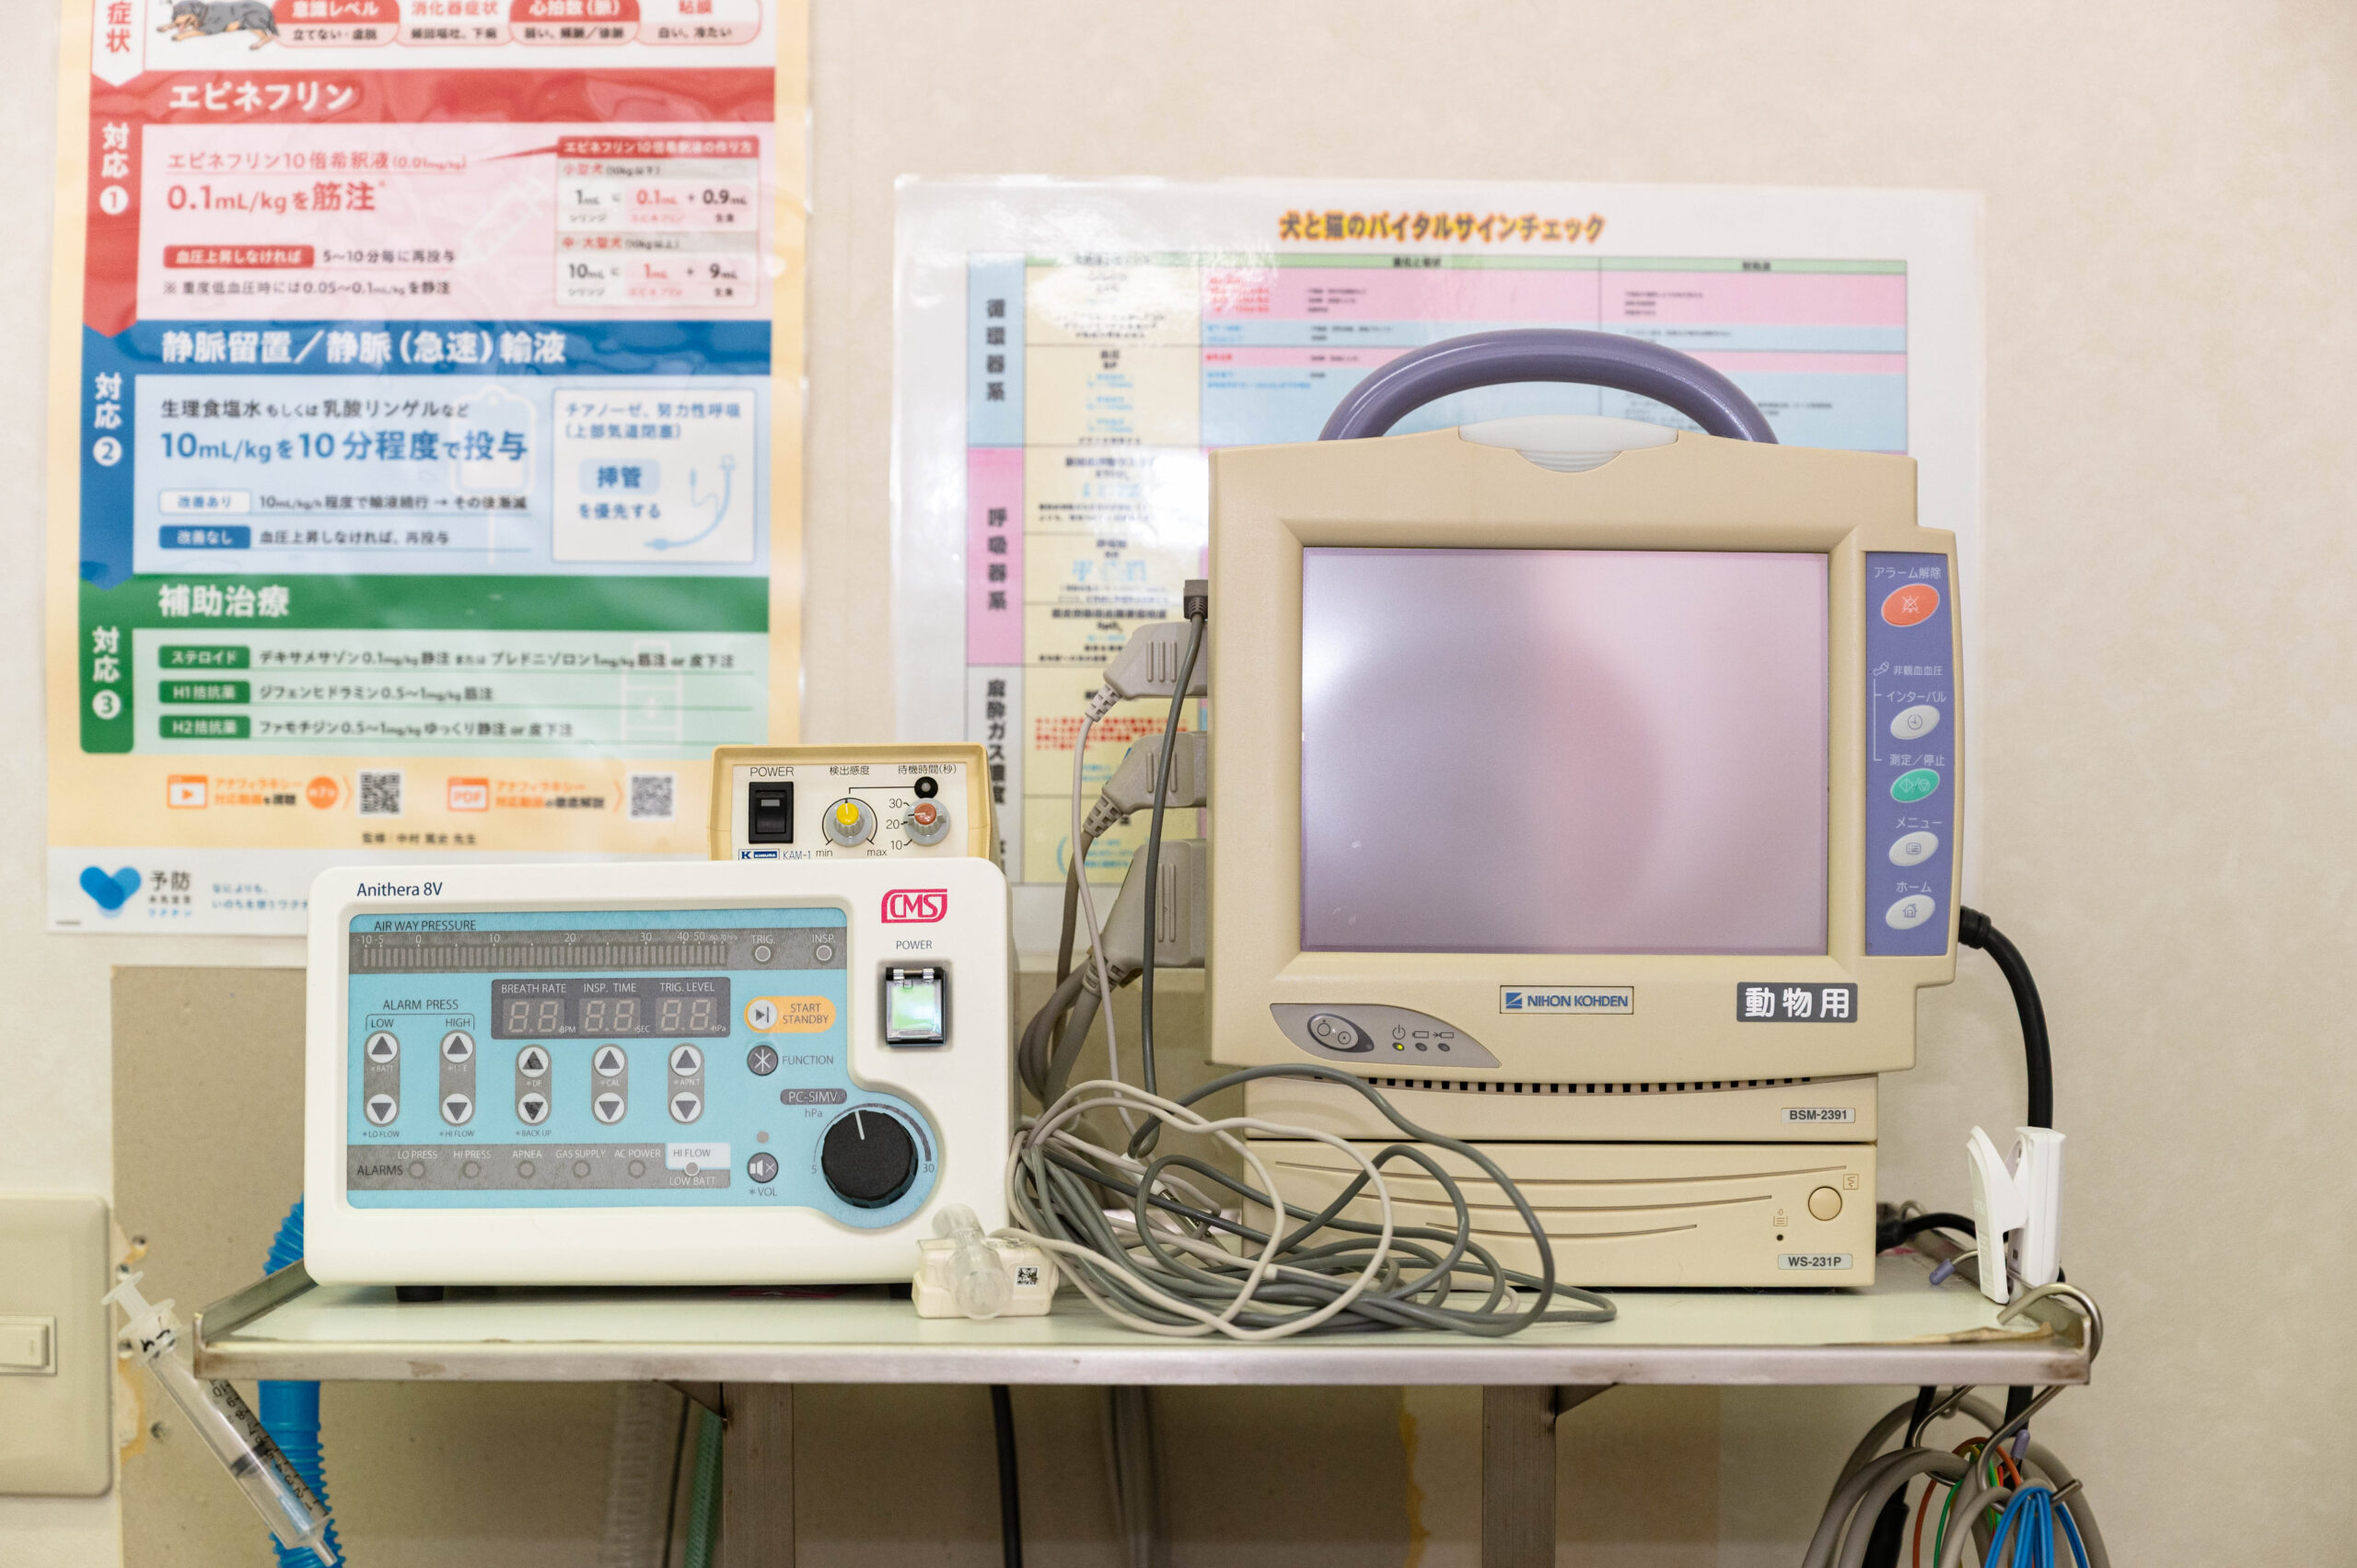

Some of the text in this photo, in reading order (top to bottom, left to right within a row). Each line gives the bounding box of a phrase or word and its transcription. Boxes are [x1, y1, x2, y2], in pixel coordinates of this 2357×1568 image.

[106, 2, 132, 53] 症状
[168, 81, 354, 112] エピネフリン
[101, 122, 130, 179] 対応
[1278, 210, 1606, 243] 犬と猫のバイタルサインチェック
[176, 249, 303, 264] 血圧上昇しなければ
[160, 330, 566, 365] 静脈留置／静脈（急速）輸液
[94, 371, 122, 430] 対応
[565, 402, 742, 420] チアノーゼ、努力性呼吸
[597, 465, 642, 489] 挿管
[177, 494, 233, 509] 改善あり
[579, 503, 662, 521] を優先する
[177, 530, 233, 546] 改善なし
[987, 508, 1008, 610] 呼吸器系
[1874, 566, 1942, 580] アラーム解除
[158, 584, 290, 618] 補助治療
[92, 626, 120, 683] 対応
[171, 650, 238, 666] ステロイド
[1893, 665, 1944, 677] 非観血血圧
[1886, 691, 1947, 703] インターバル
[1889, 753, 1946, 767] 測定／停止
[749, 766, 795, 777] POWER
[829, 765, 870, 776] 検出感度
[897, 763, 958, 775] 待機時間(秒)
[888, 798, 902, 808] 30
[886, 819, 900, 830] 20
[1896, 816, 1943, 830] メニュー
[890, 840, 902, 850] 10
[783, 850, 811, 860] KAM-1
[816, 848, 833, 857] min
[866, 849, 888, 857] max
[149, 870, 191, 892] 予防
[1896, 880, 1933, 893] ホーム
[356, 882, 443, 897] Anithera 8V
[887, 892, 942, 920] CMS
[374, 920, 477, 932] AIR WAY PRESSURE
[415, 934, 422, 944] 0
[489, 934, 501, 943] 10
[563, 933, 576, 943] 20
[640, 933, 653, 942] 30
[677, 932, 690, 941] 40
[693, 931, 705, 941] 50
[751, 935, 776, 945] TRIG.
[812, 934, 836, 944] INSP.
[896, 939, 933, 950] POWER
[501, 982, 567, 993] BREATH RATE
[584, 981, 637, 993] INSP. TIME
[659, 981, 715, 992] TRIG. LEVEL
[383, 999, 459, 1010] ALARM PRESS
[1527, 994, 1629, 1007] NIHON KOHDEN
[1745, 986, 1850, 1019] 動物用
[790, 1003, 821, 1013] START
[371, 1018, 394, 1028] LOW
[445, 1017, 470, 1028] HIGH
[783, 1015, 830, 1025] STANDBY
[782, 1055, 834, 1065] FUNCTION
[788, 1091, 839, 1103] PC-SIMV
[805, 1109, 823, 1118] hPa
[1789, 1109, 1848, 1121] BSM-2391
[368, 1130, 401, 1138] LO FLOW
[445, 1130, 453, 1138] HI
[521, 1129, 552, 1138] BACK UP
[397, 1150, 438, 1159] LO PRESS
[453, 1150, 492, 1159] HI PRESS
[512, 1150, 543, 1159] APNEA
[555, 1149, 606, 1158] GAS SUPPLY
[614, 1148, 661, 1157] AC POWER
[673, 1148, 712, 1157] HI FLOW
[356, 1165, 403, 1176] ALARMS
[810, 1166, 818, 1174] 5
[923, 1164, 935, 1173] 30
[669, 1176, 716, 1186] LOW BATT
[758, 1187, 778, 1197] VOL
[1788, 1257, 1842, 1267] WS-231P
